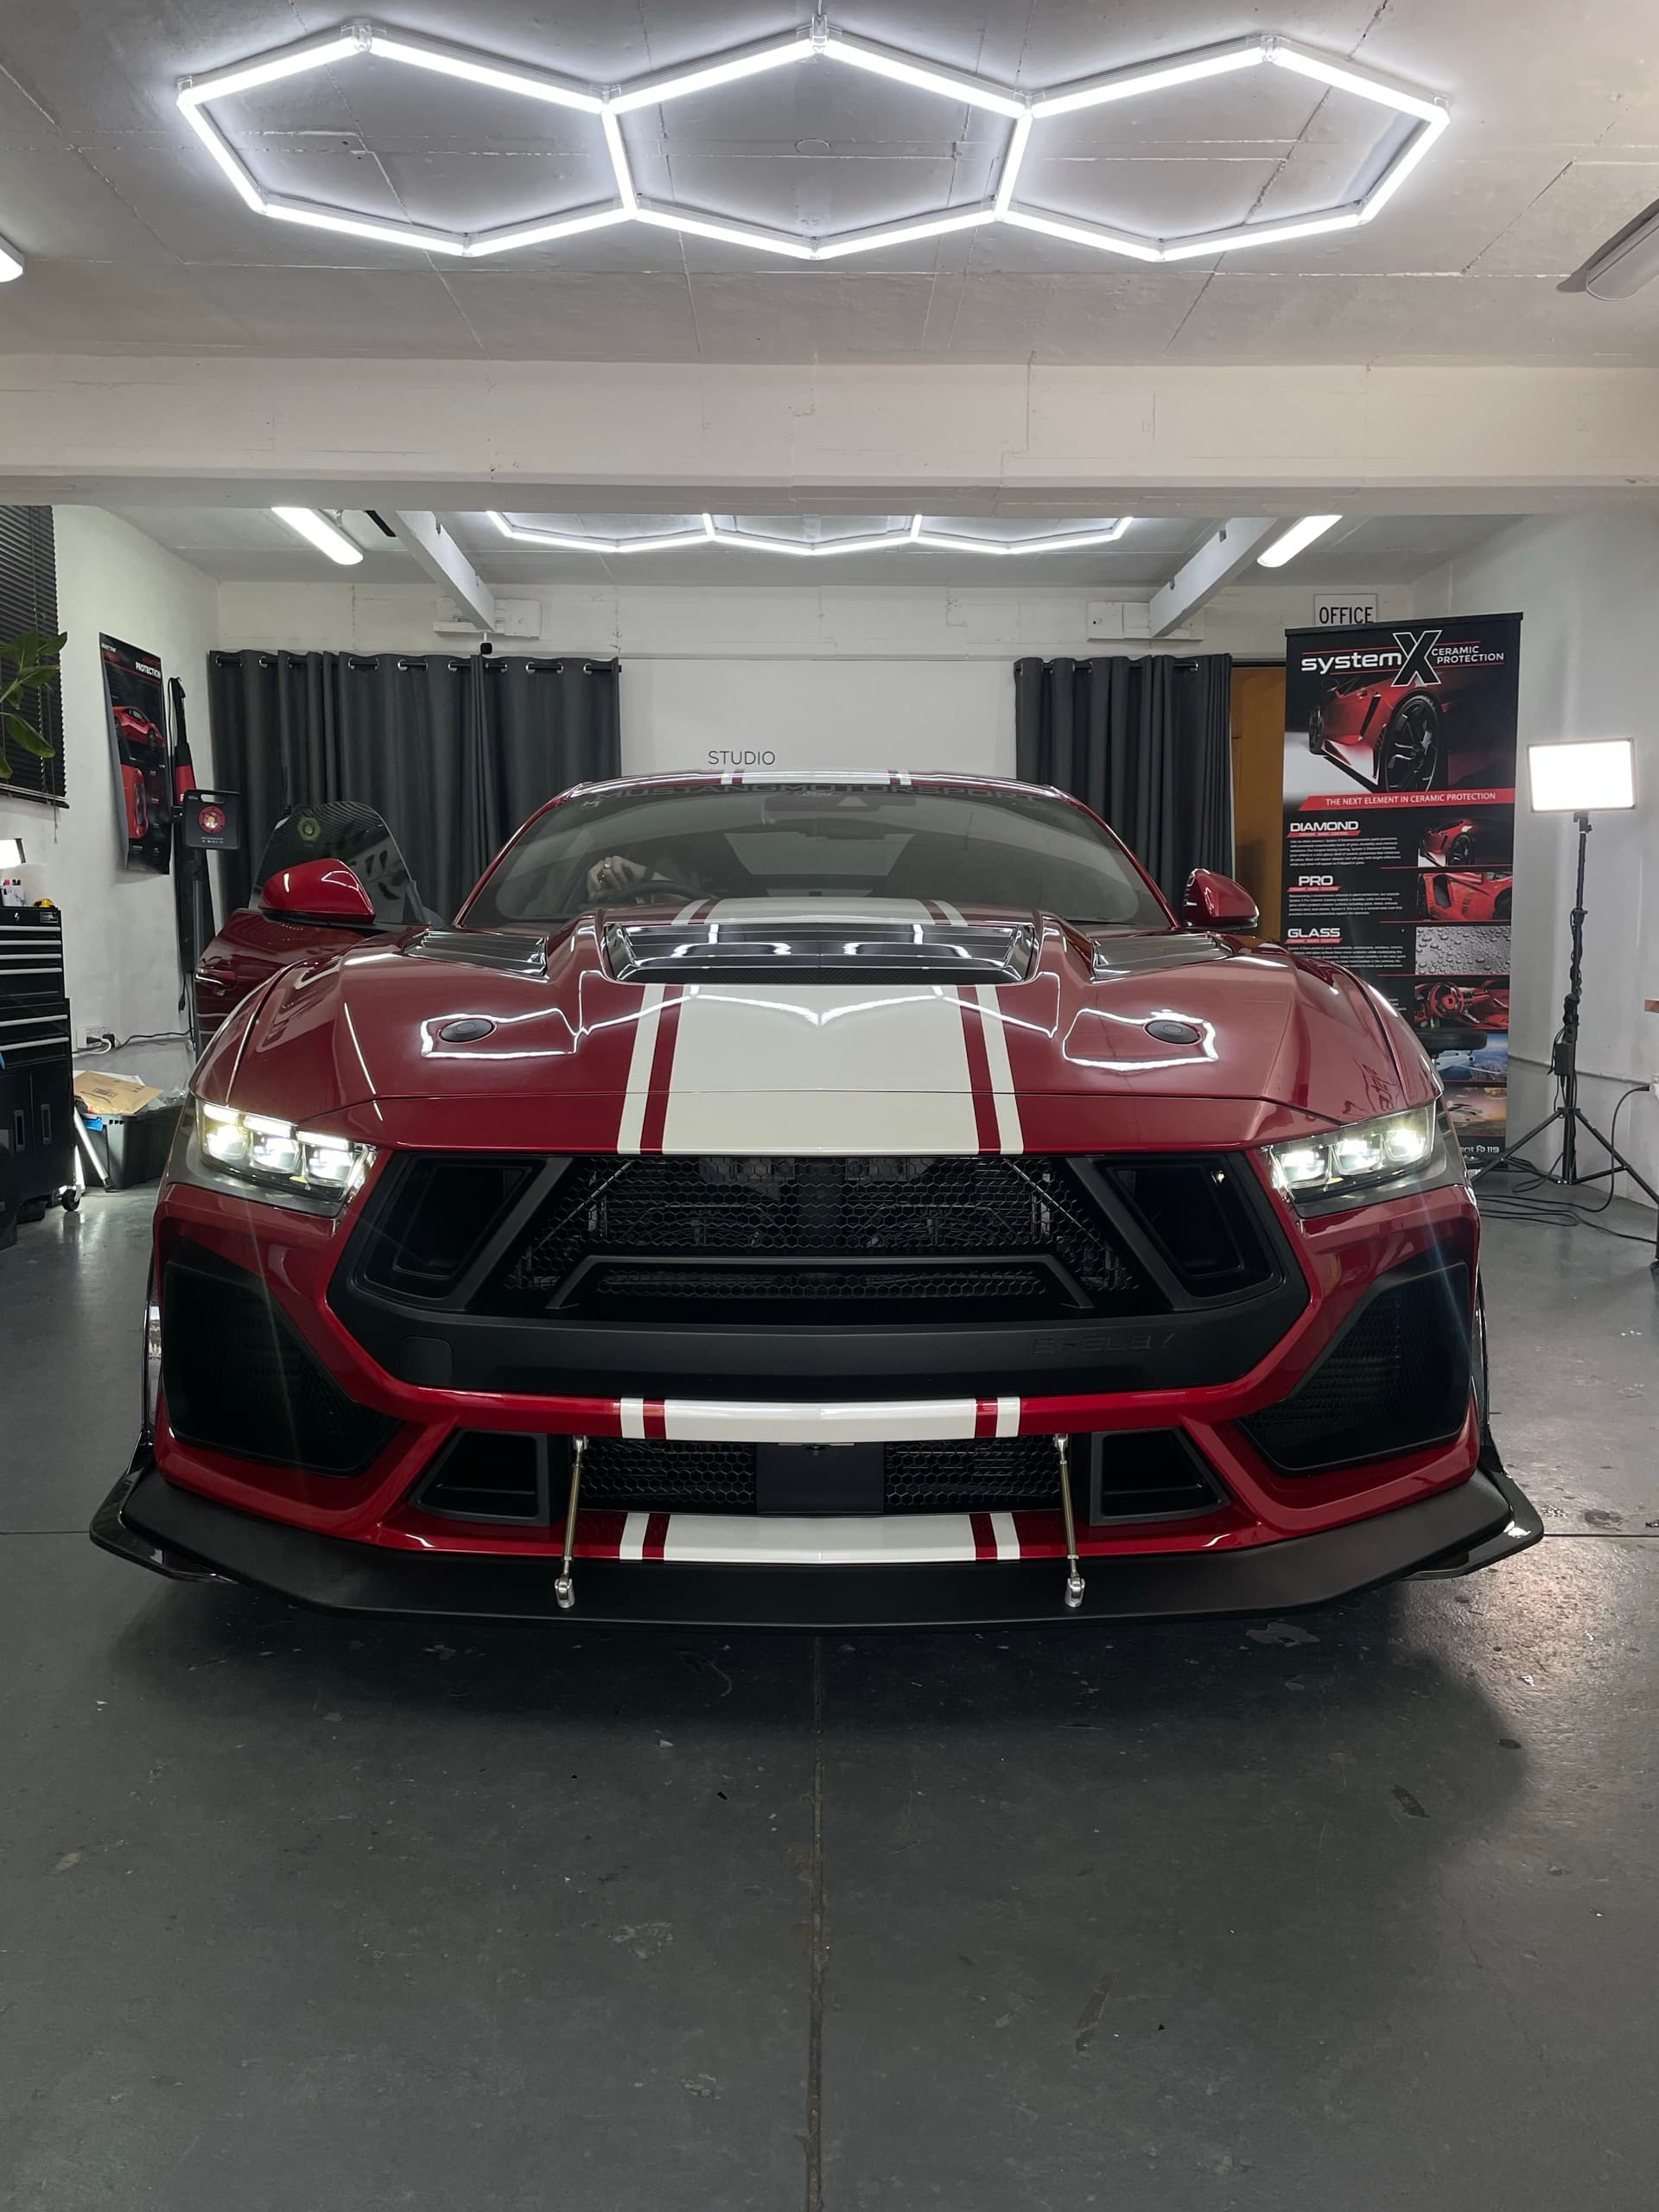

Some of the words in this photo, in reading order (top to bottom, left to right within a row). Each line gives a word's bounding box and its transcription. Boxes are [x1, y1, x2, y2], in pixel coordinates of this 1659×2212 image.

[1319, 607, 1374, 624] OFFICE
[1432, 645, 1479, 657] CERAMIC
[1436, 653, 1504, 664] PROTECTION
[708, 750, 776, 766] STUDIO
[1325, 798, 1342, 806] THE
[1343, 797, 1363, 805] NEXT
[1363, 796, 1398, 804] ELEMENT
[1400, 795, 1409, 804] IN
[1410, 794, 1446, 803] CERAMIC
[1446, 792, 1497, 802] PROTECTION
[1290, 821, 1359, 832] DIAMOND
[1299, 875, 1333, 886] PRO
[1287, 928, 1341, 938] GLASS
